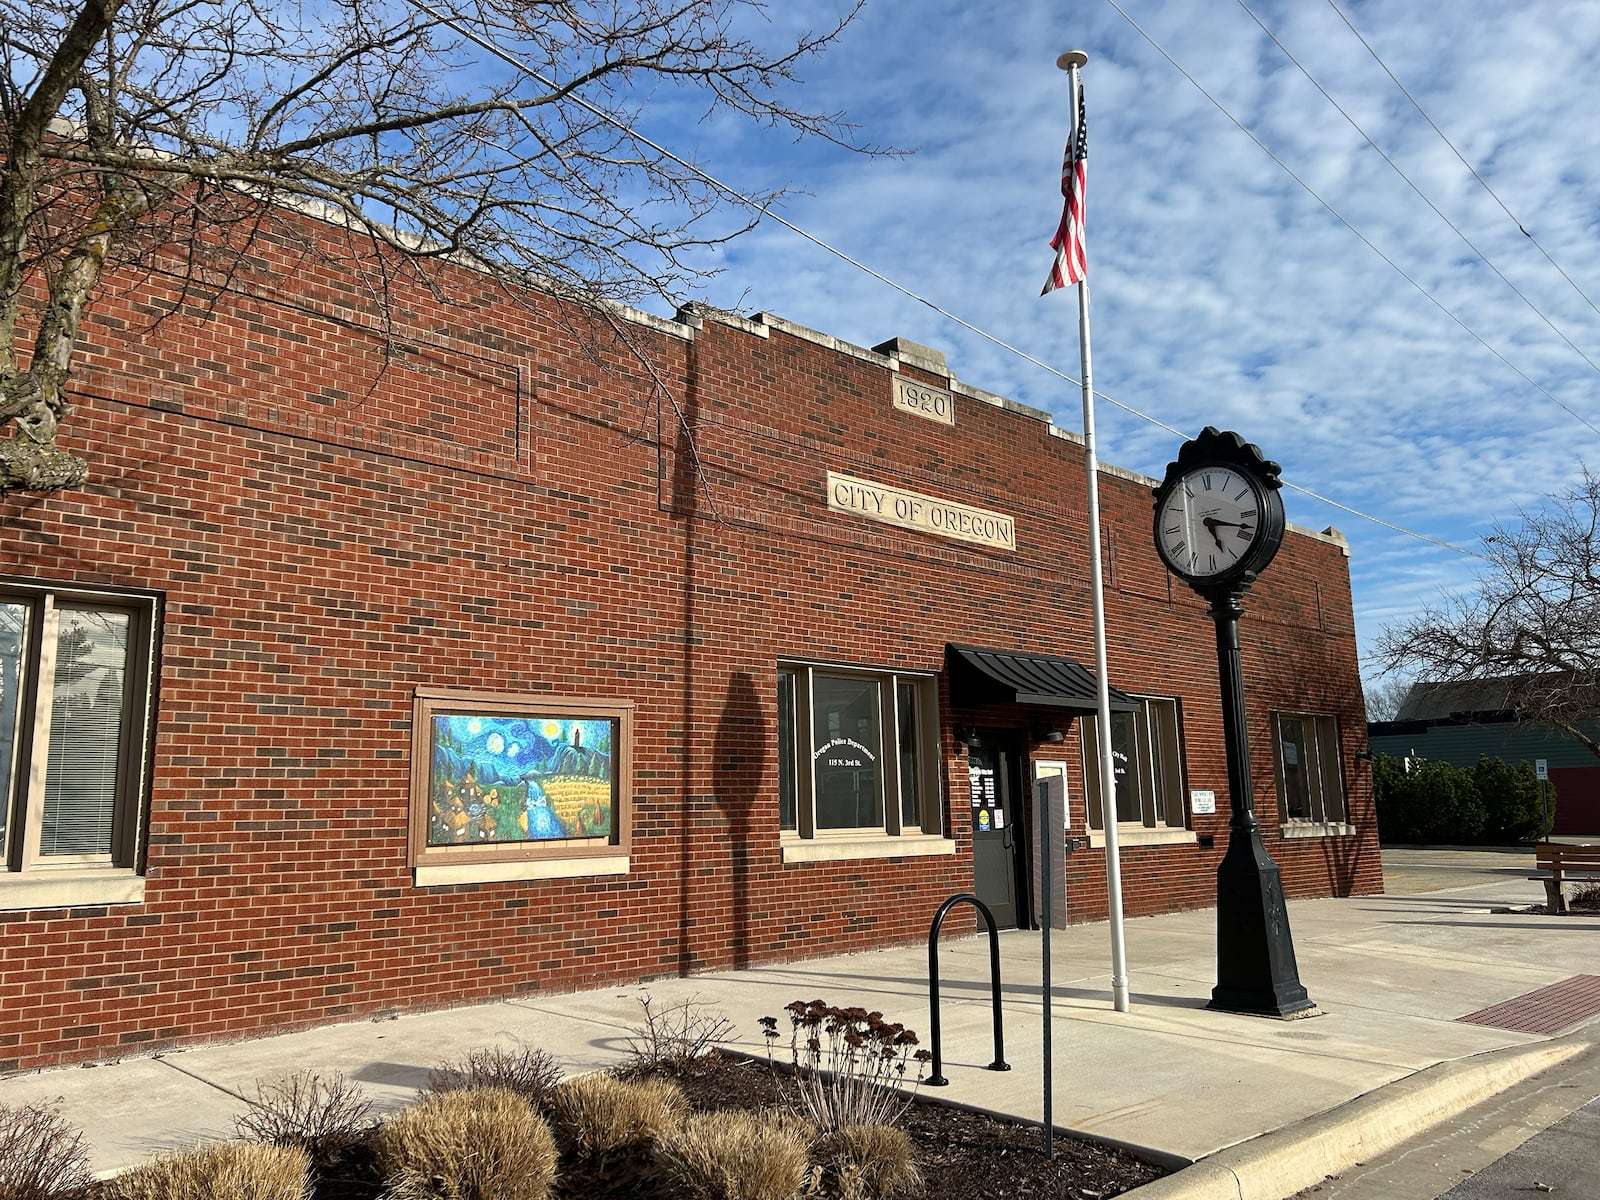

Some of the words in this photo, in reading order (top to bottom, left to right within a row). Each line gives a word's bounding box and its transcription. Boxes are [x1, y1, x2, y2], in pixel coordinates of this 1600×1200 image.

[899, 384, 945, 418] 1920
[834, 482, 885, 514] CITY
[895, 497, 923, 522] OF
[931, 506, 1009, 543] OREGON
[813, 742, 831, 760] Oregon
[831, 737, 847, 747] Police
[847, 738, 876, 762] Department
[828, 758, 838, 767] 115
[845, 759, 854, 767] 3rd
